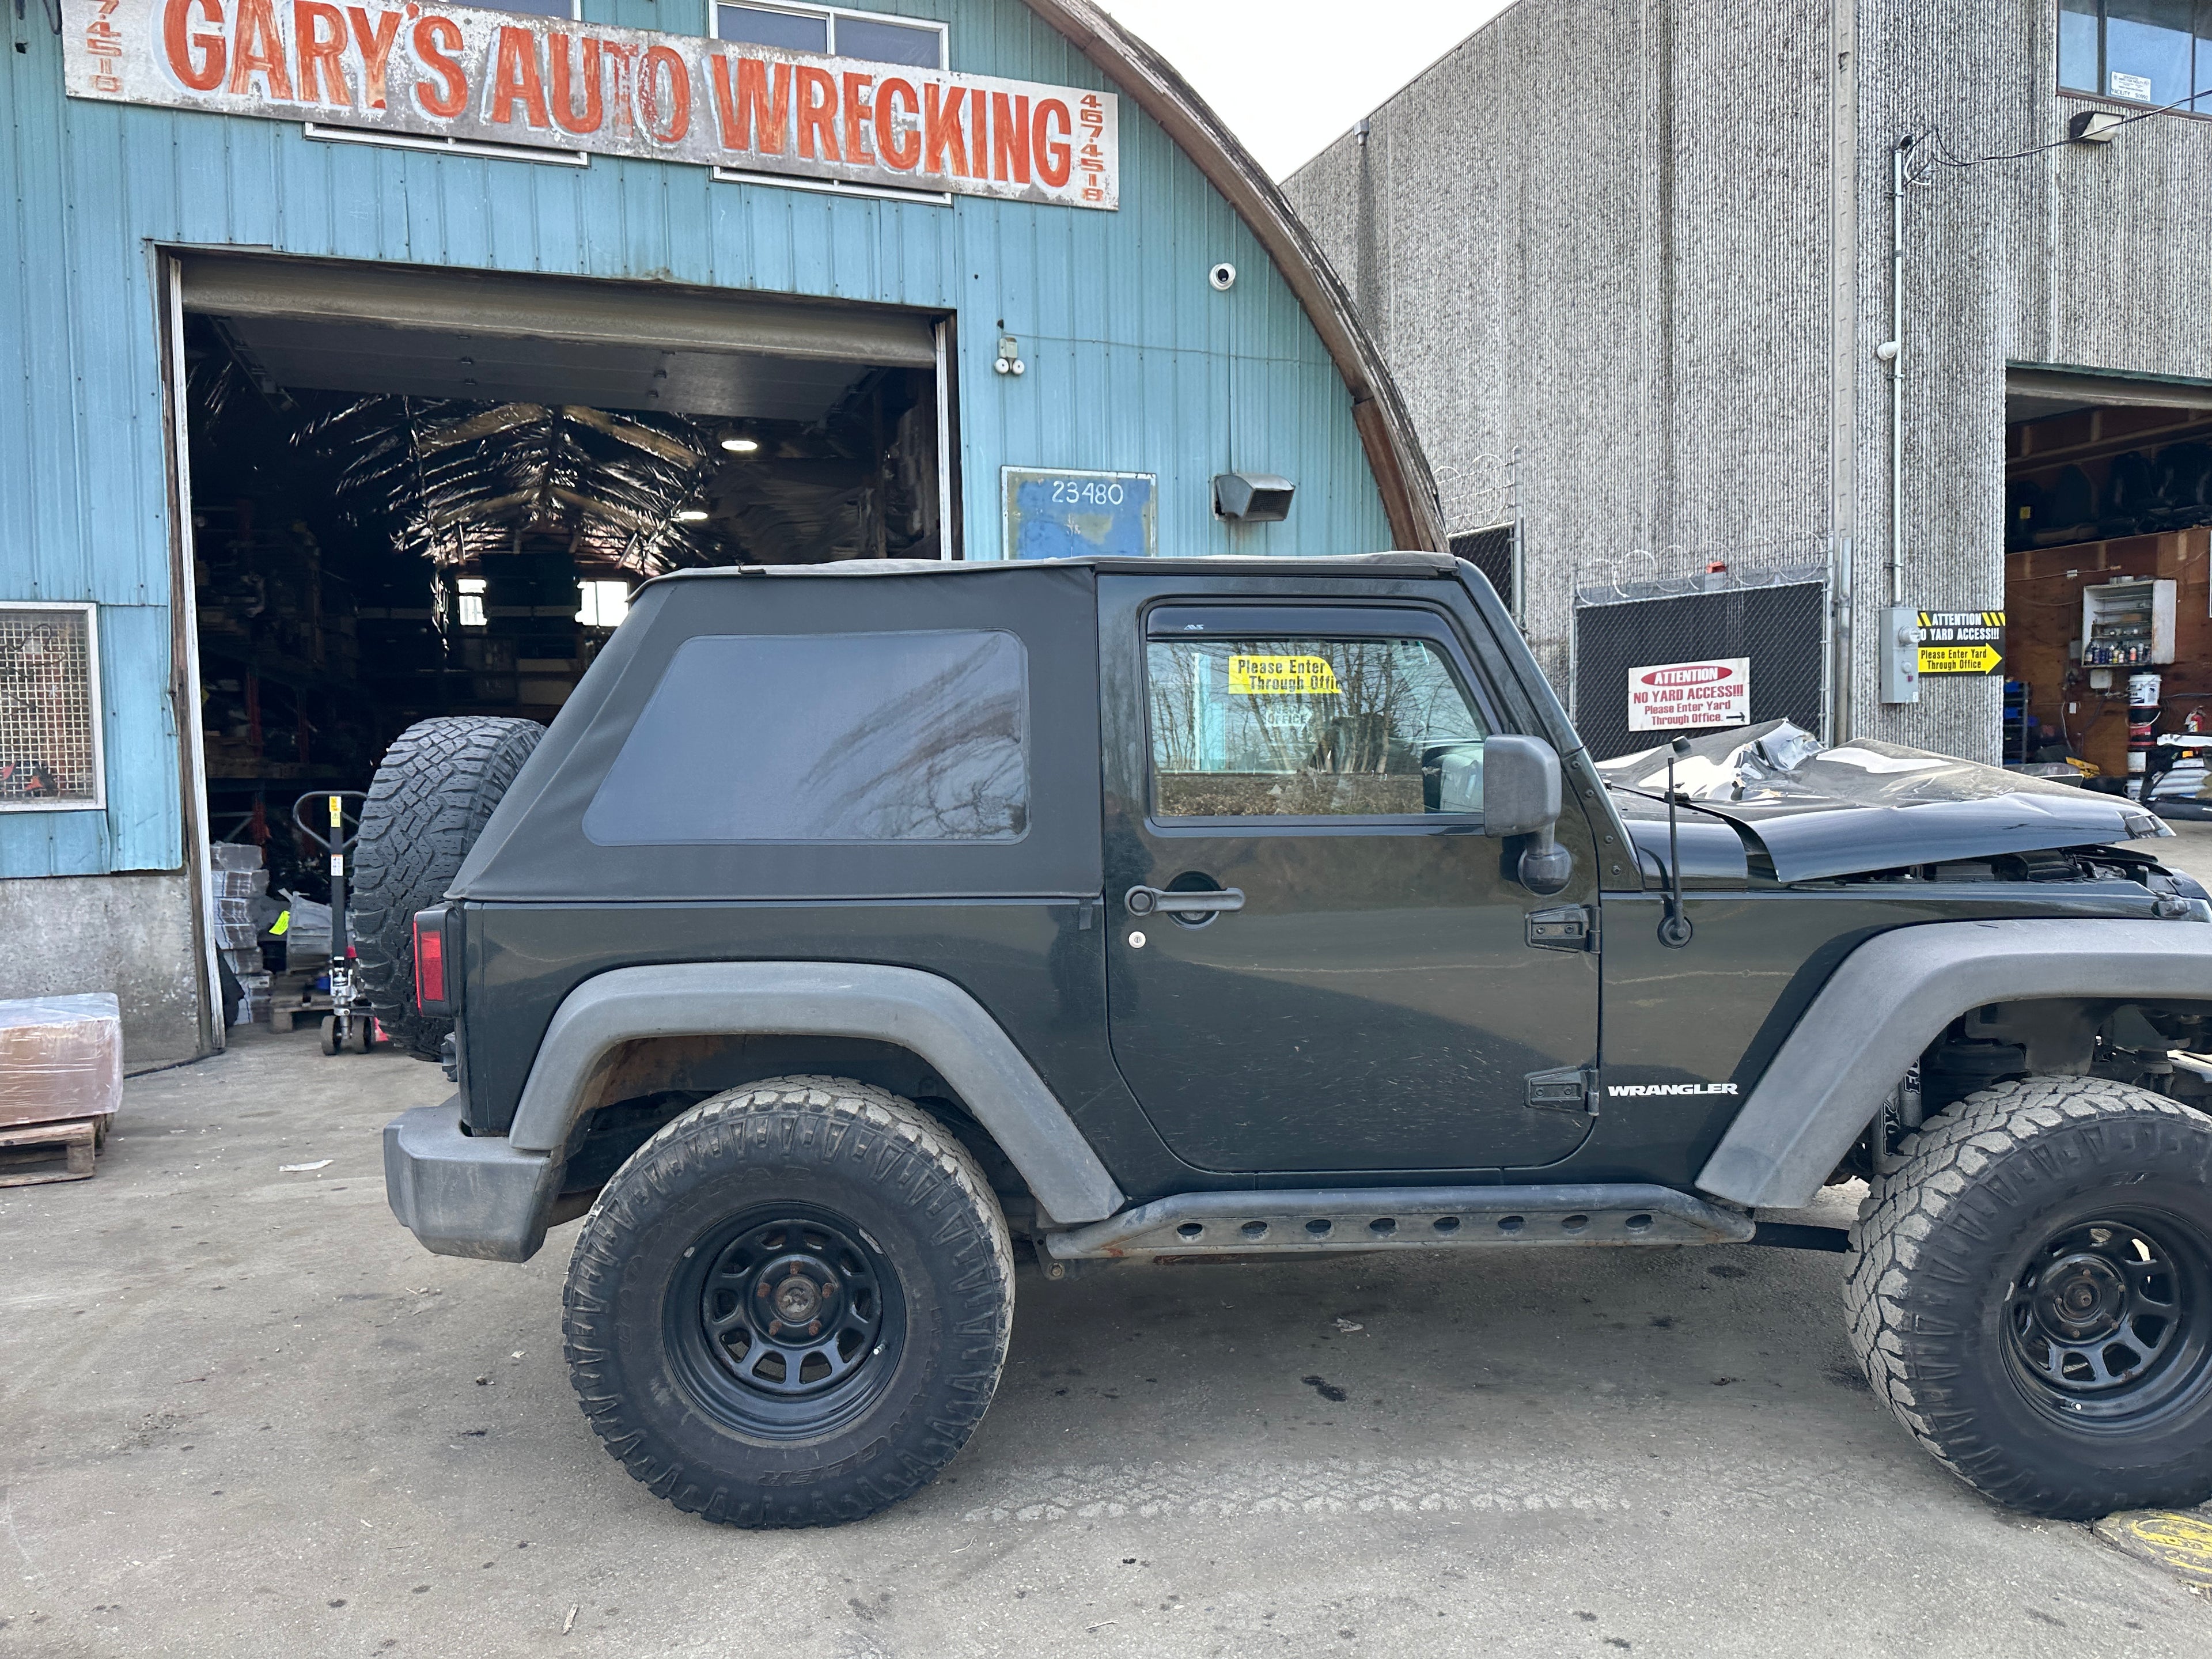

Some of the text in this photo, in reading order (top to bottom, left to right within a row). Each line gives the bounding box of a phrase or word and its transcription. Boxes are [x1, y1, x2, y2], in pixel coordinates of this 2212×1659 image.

[164, 0, 1072, 188] GARY'S AUTO WRECKING
[1052, 480, 1124, 505] 23480
[1932, 613, 1982, 626] ATTENTION
[1930, 627, 1954, 641] YARD
[1957, 627, 1999, 641] ACCESS!!!
[1921, 649, 1987, 660] Please Enter Yard
[1238, 659, 1325, 674] Please Enter
[1927, 659, 1982, 671] Through Office
[1249, 675, 1304, 692] Through
[1654, 667, 1718, 685] ATTENTION
[1634, 684, 1744, 704] NO YARD ACCESS!!!
[1645, 700, 1731, 715] Please Enter Yard
[1652, 715, 1690, 725] Through
[1608, 1083, 1738, 1097] WRANGLER
